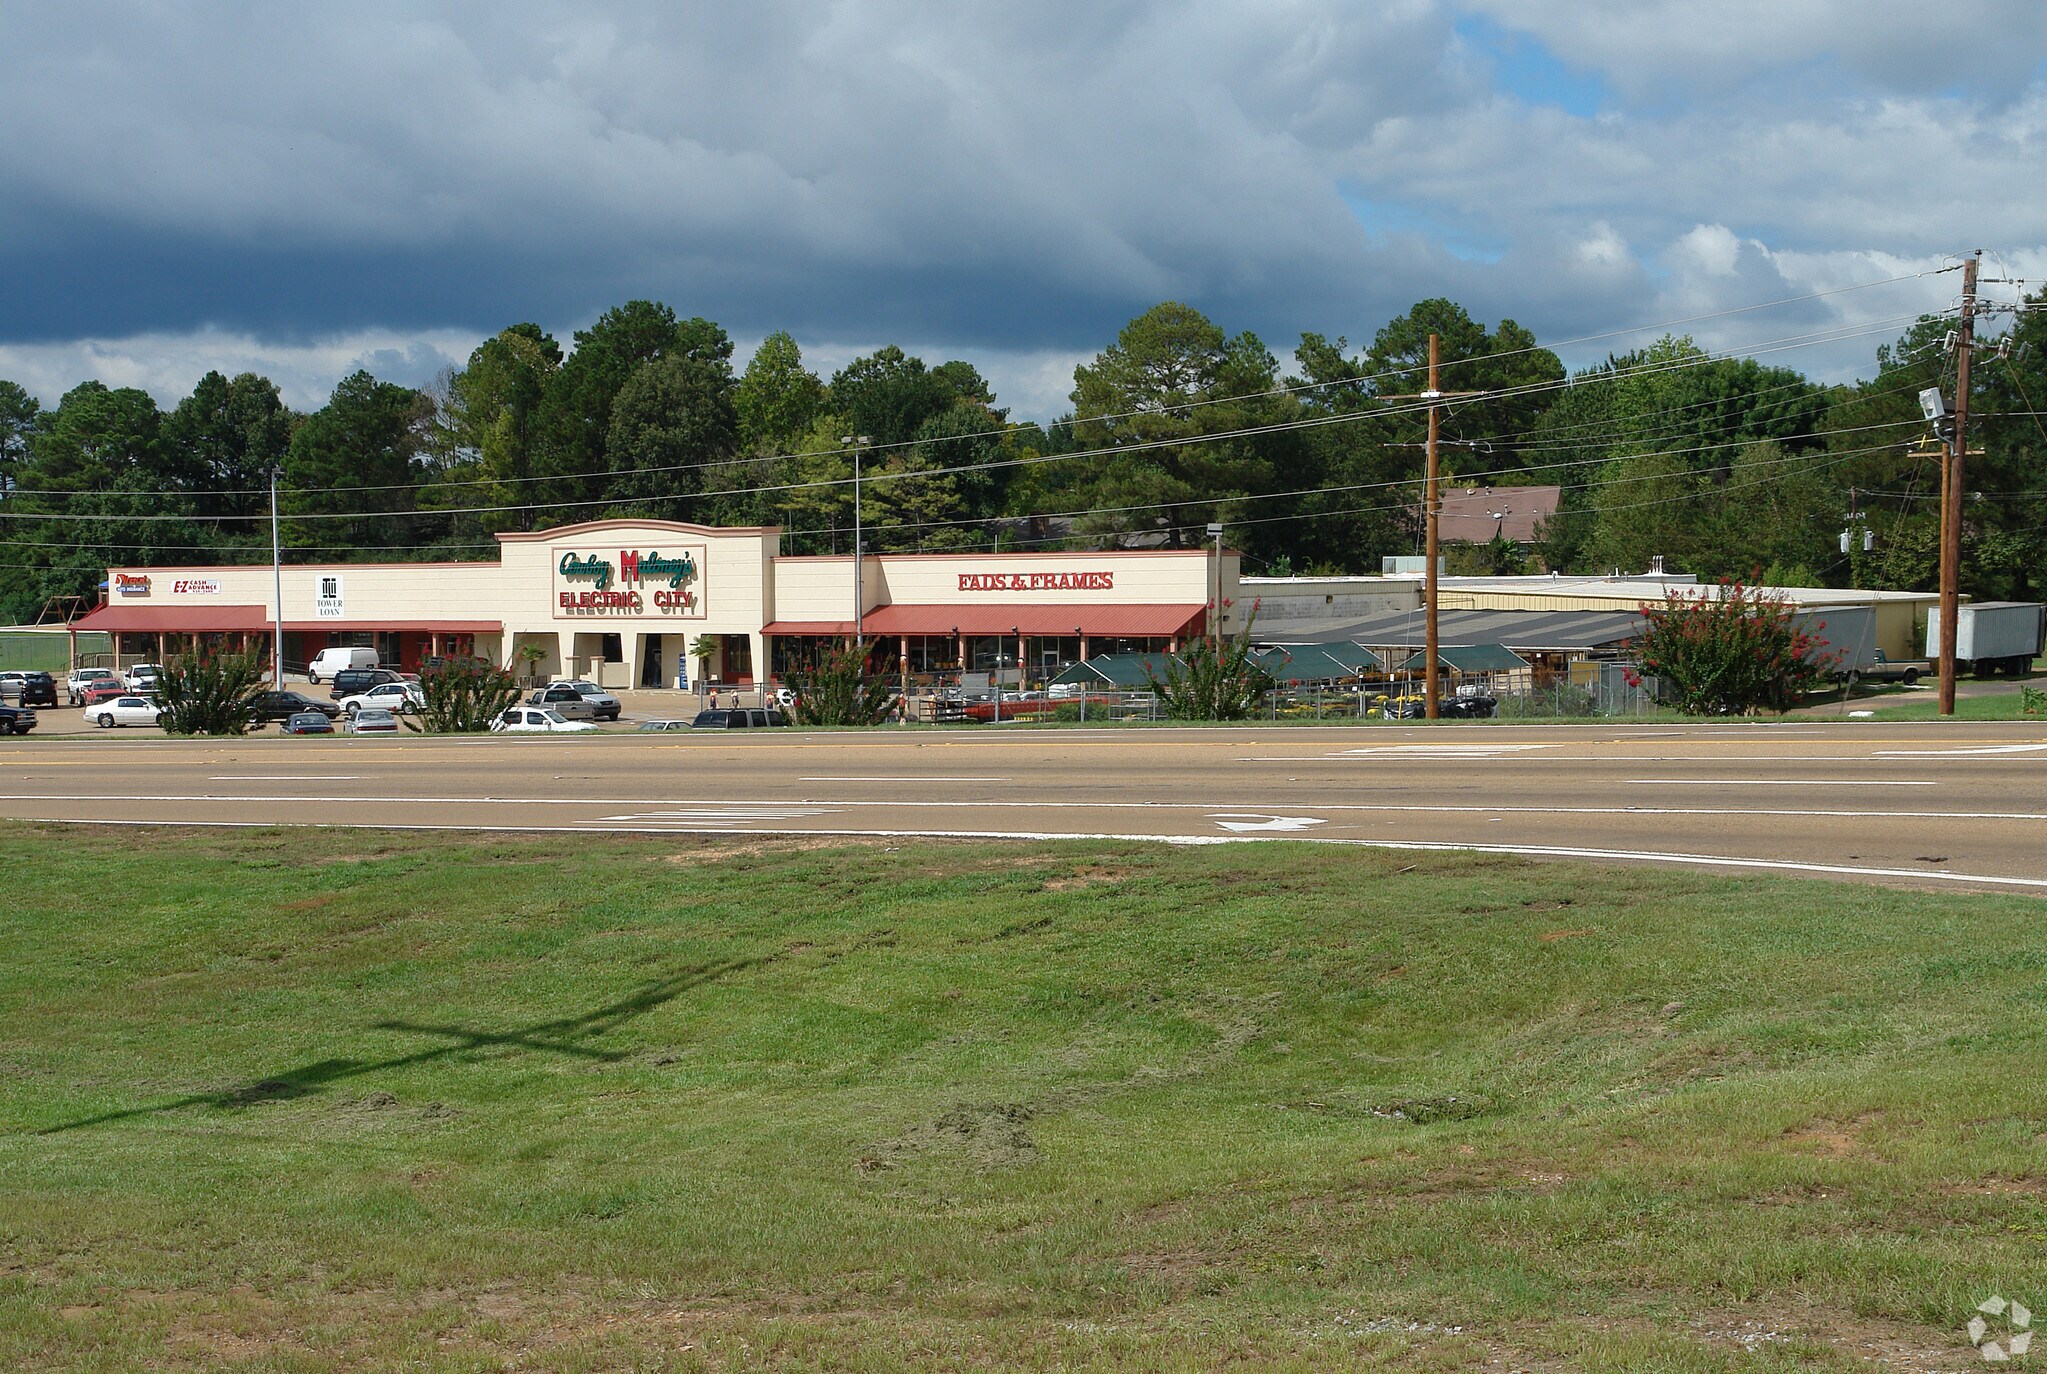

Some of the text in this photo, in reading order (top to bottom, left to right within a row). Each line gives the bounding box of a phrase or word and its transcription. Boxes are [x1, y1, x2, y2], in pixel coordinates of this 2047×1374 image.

[559, 550, 693, 590] Cowboy Maloney's
[957, 572, 1114, 591] FADS & FRAMES
[317, 599, 343, 607] TOWER
[559, 590, 693, 608] ELECTRIC CITY
[320, 608, 340, 616] LOAN
